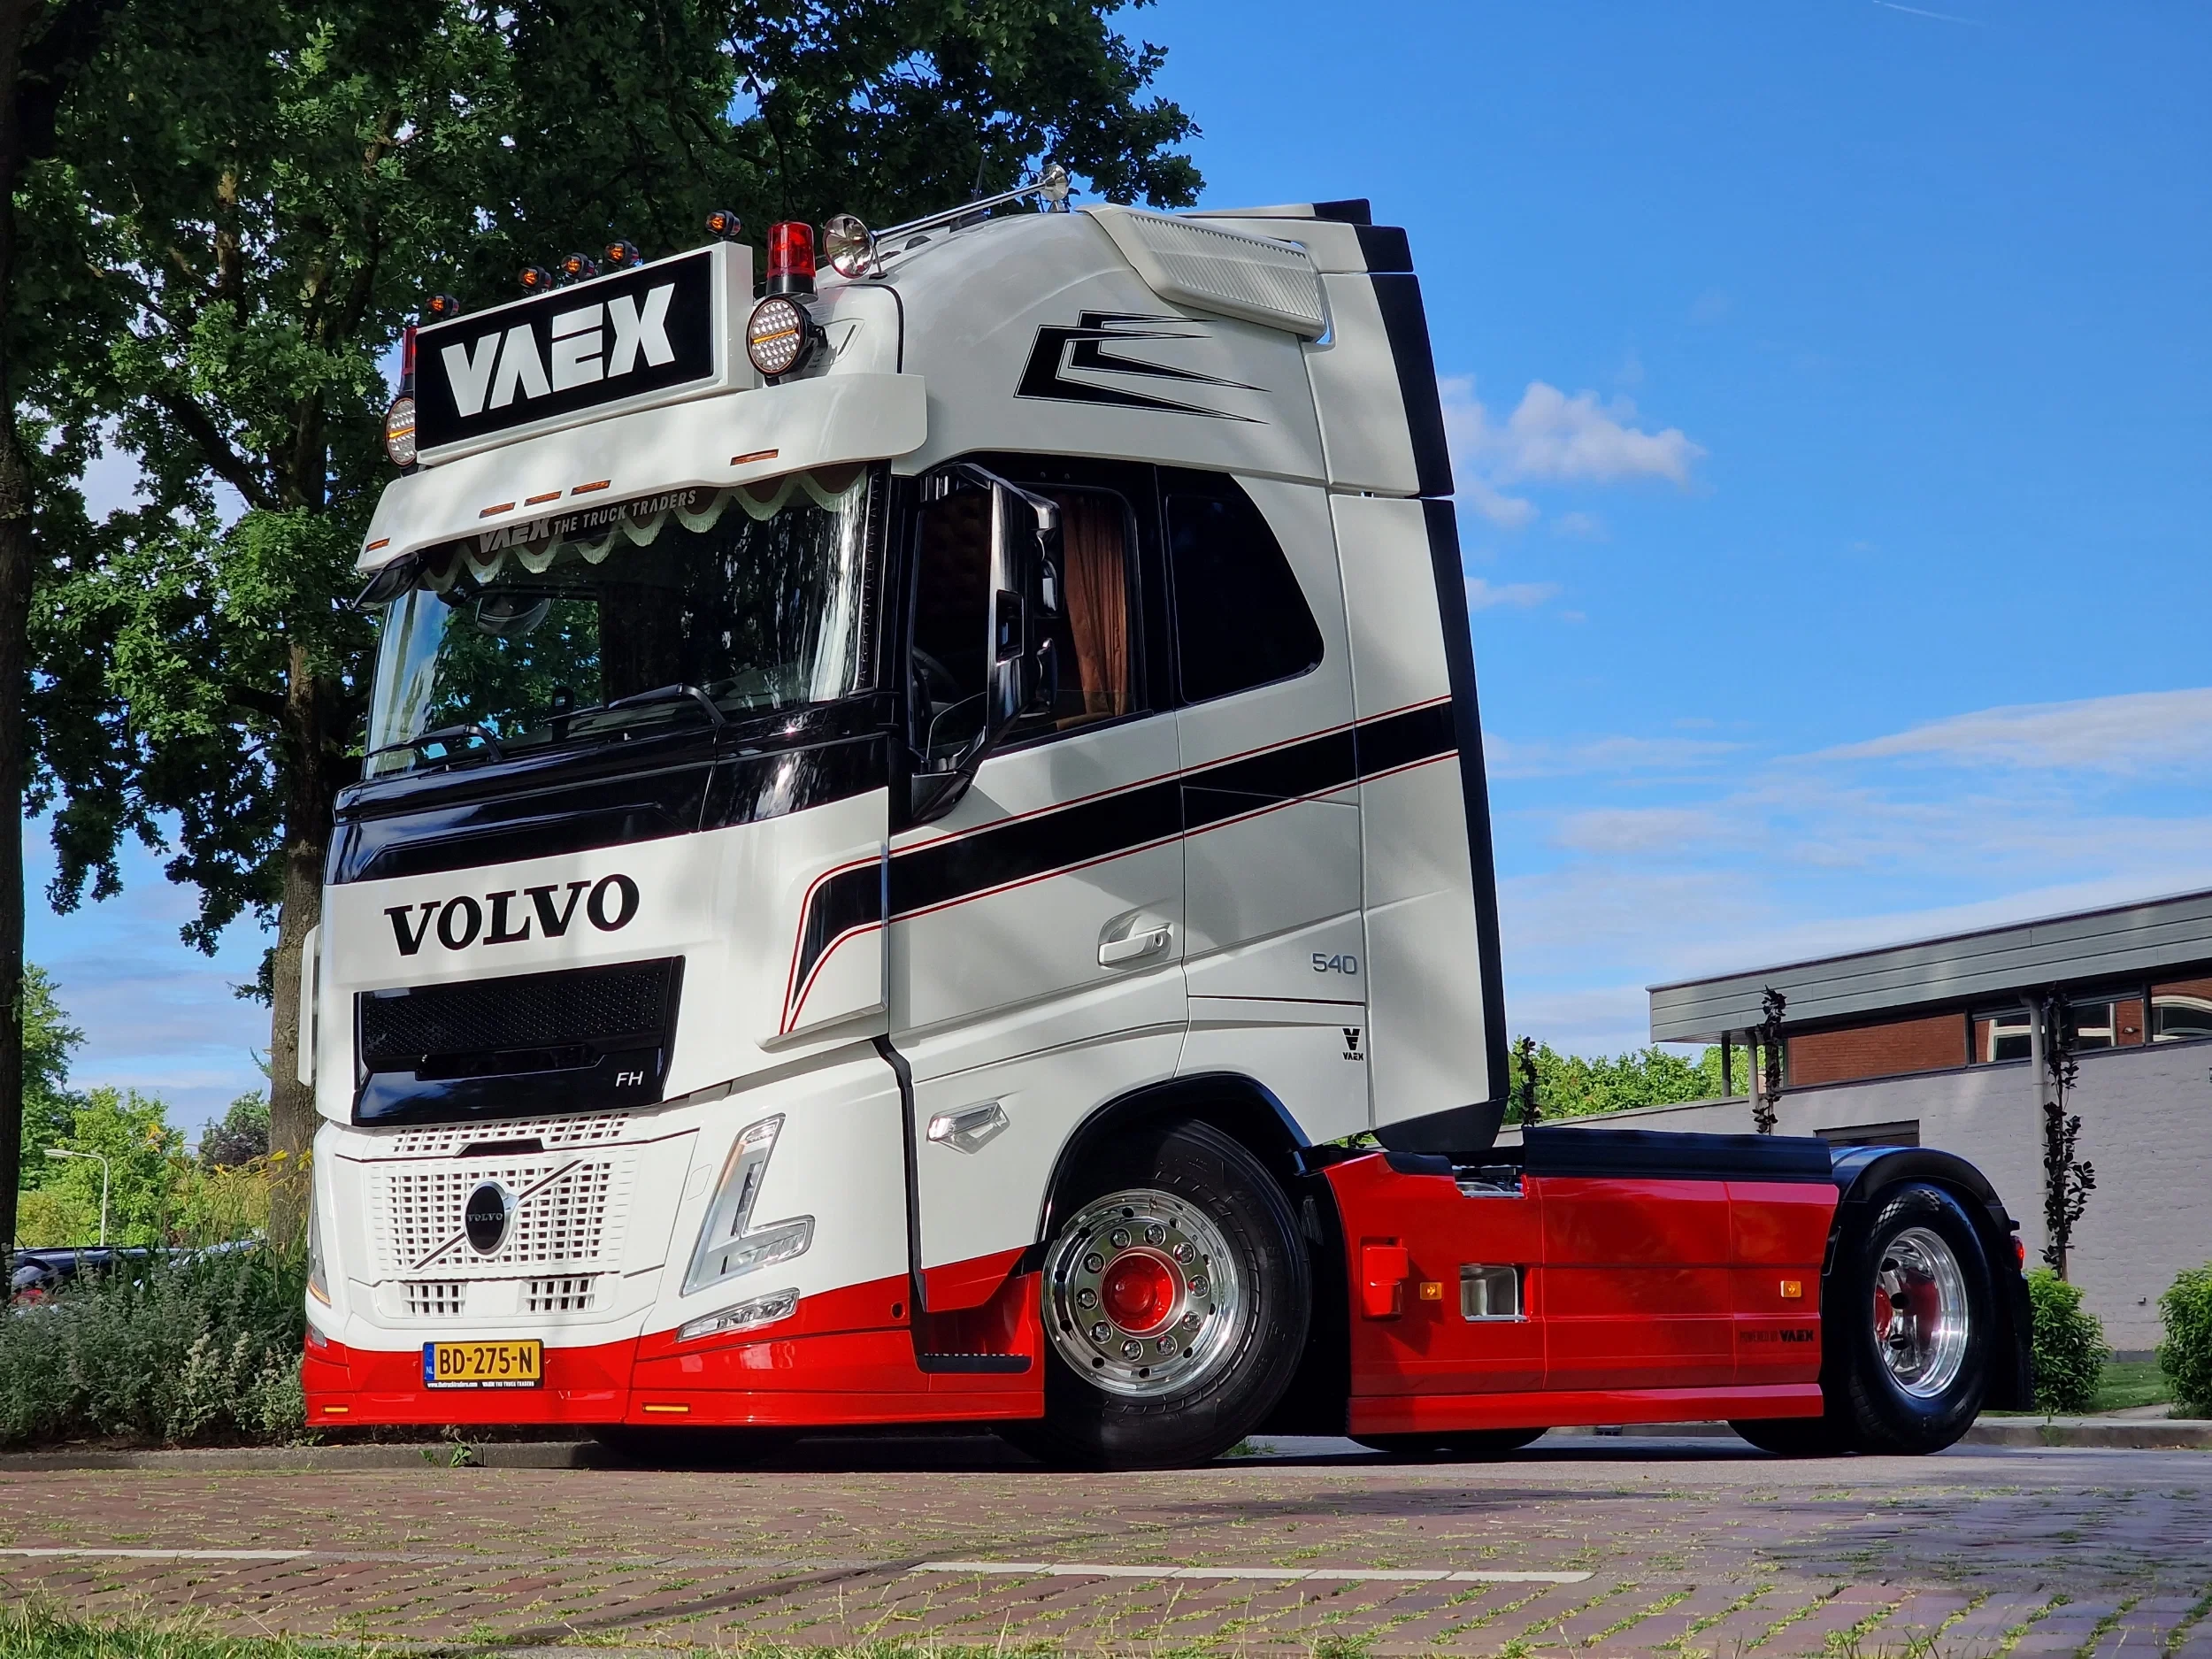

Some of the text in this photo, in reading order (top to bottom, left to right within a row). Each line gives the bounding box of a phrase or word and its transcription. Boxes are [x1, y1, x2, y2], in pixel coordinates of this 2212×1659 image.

[442, 283, 675, 418] VAEX
[479, 489, 696, 553] VAEX THE TRUCK TRADERS
[384, 873, 640, 956] VOLVO
[1312, 953, 1357, 974] 540
[1342, 1052, 1363, 1061] VAEX
[616, 1071, 643, 1087] FH
[1778, 1330, 1813, 1342] VAEX
[440, 1347, 532, 1374] BD-275-N
